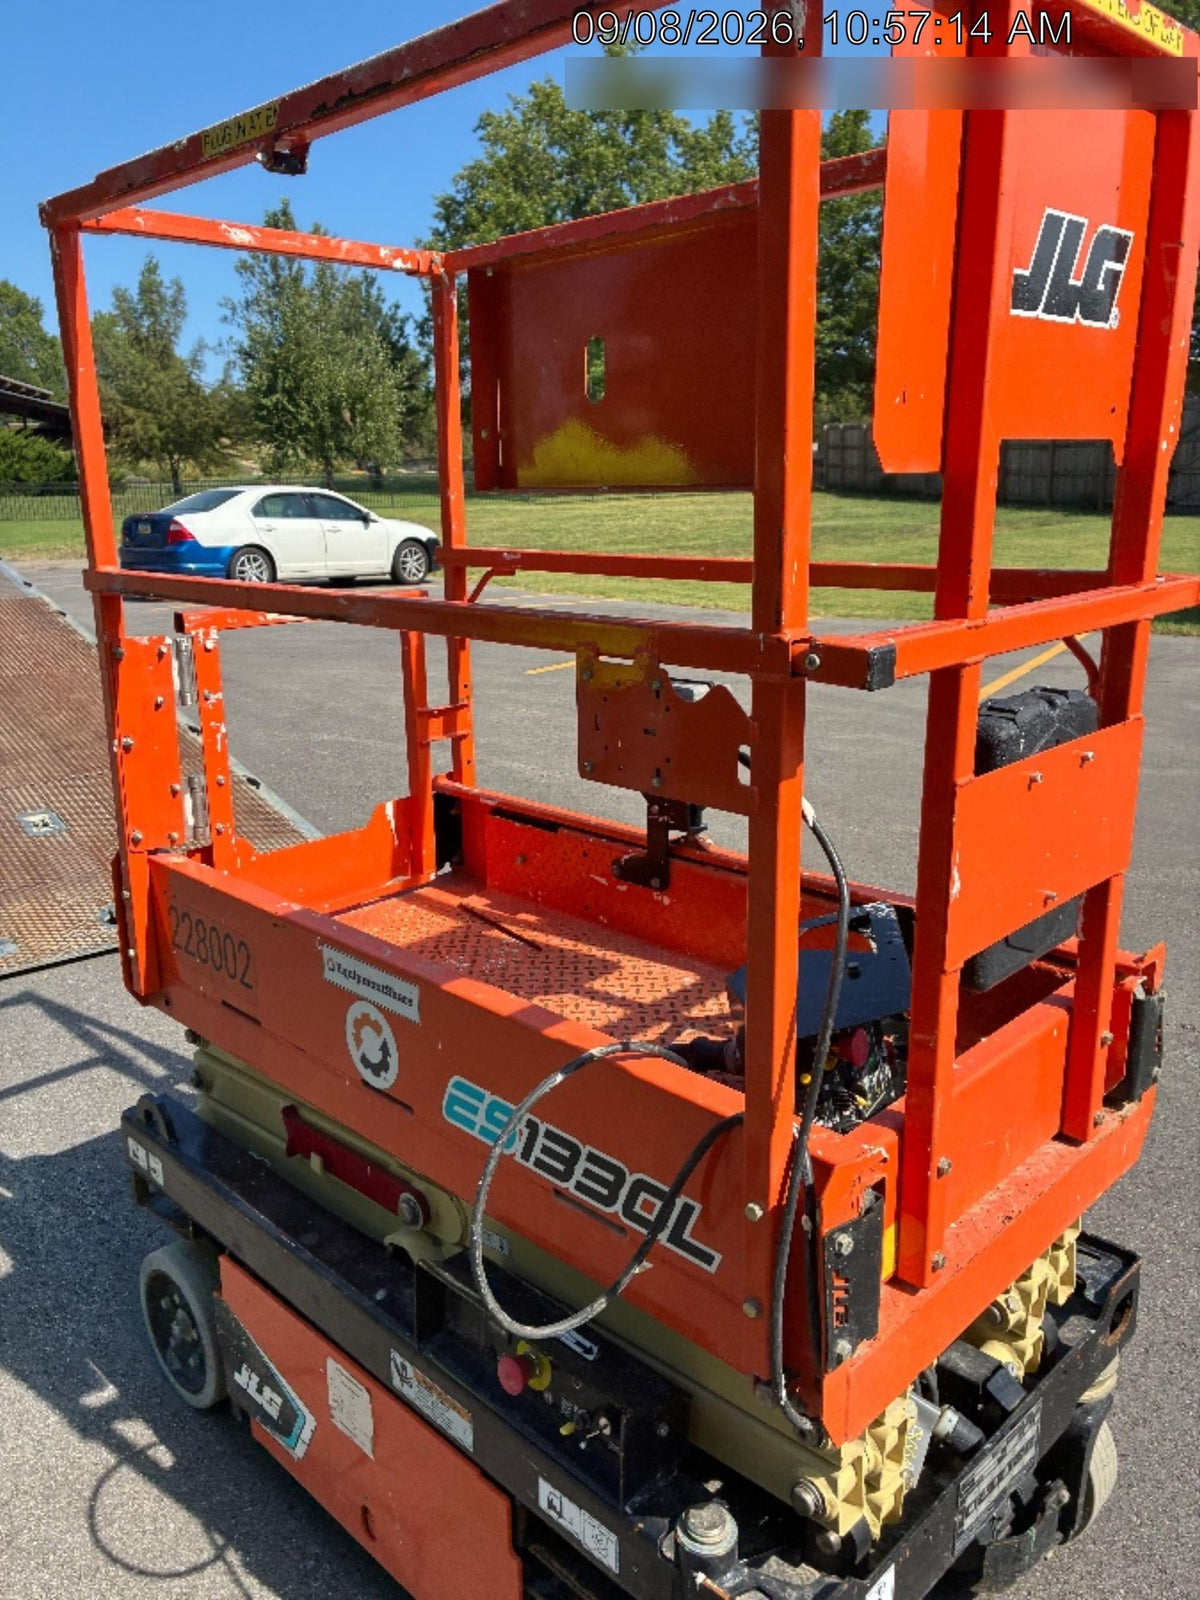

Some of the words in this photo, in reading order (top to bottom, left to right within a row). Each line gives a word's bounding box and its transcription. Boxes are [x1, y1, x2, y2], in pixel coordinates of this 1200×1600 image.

[1009, 206, 1134, 329] JLG
[168, 904, 253, 990] 228002
[442, 1075, 722, 1274] ES1330L
[234, 1363, 284, 1421] JLG
